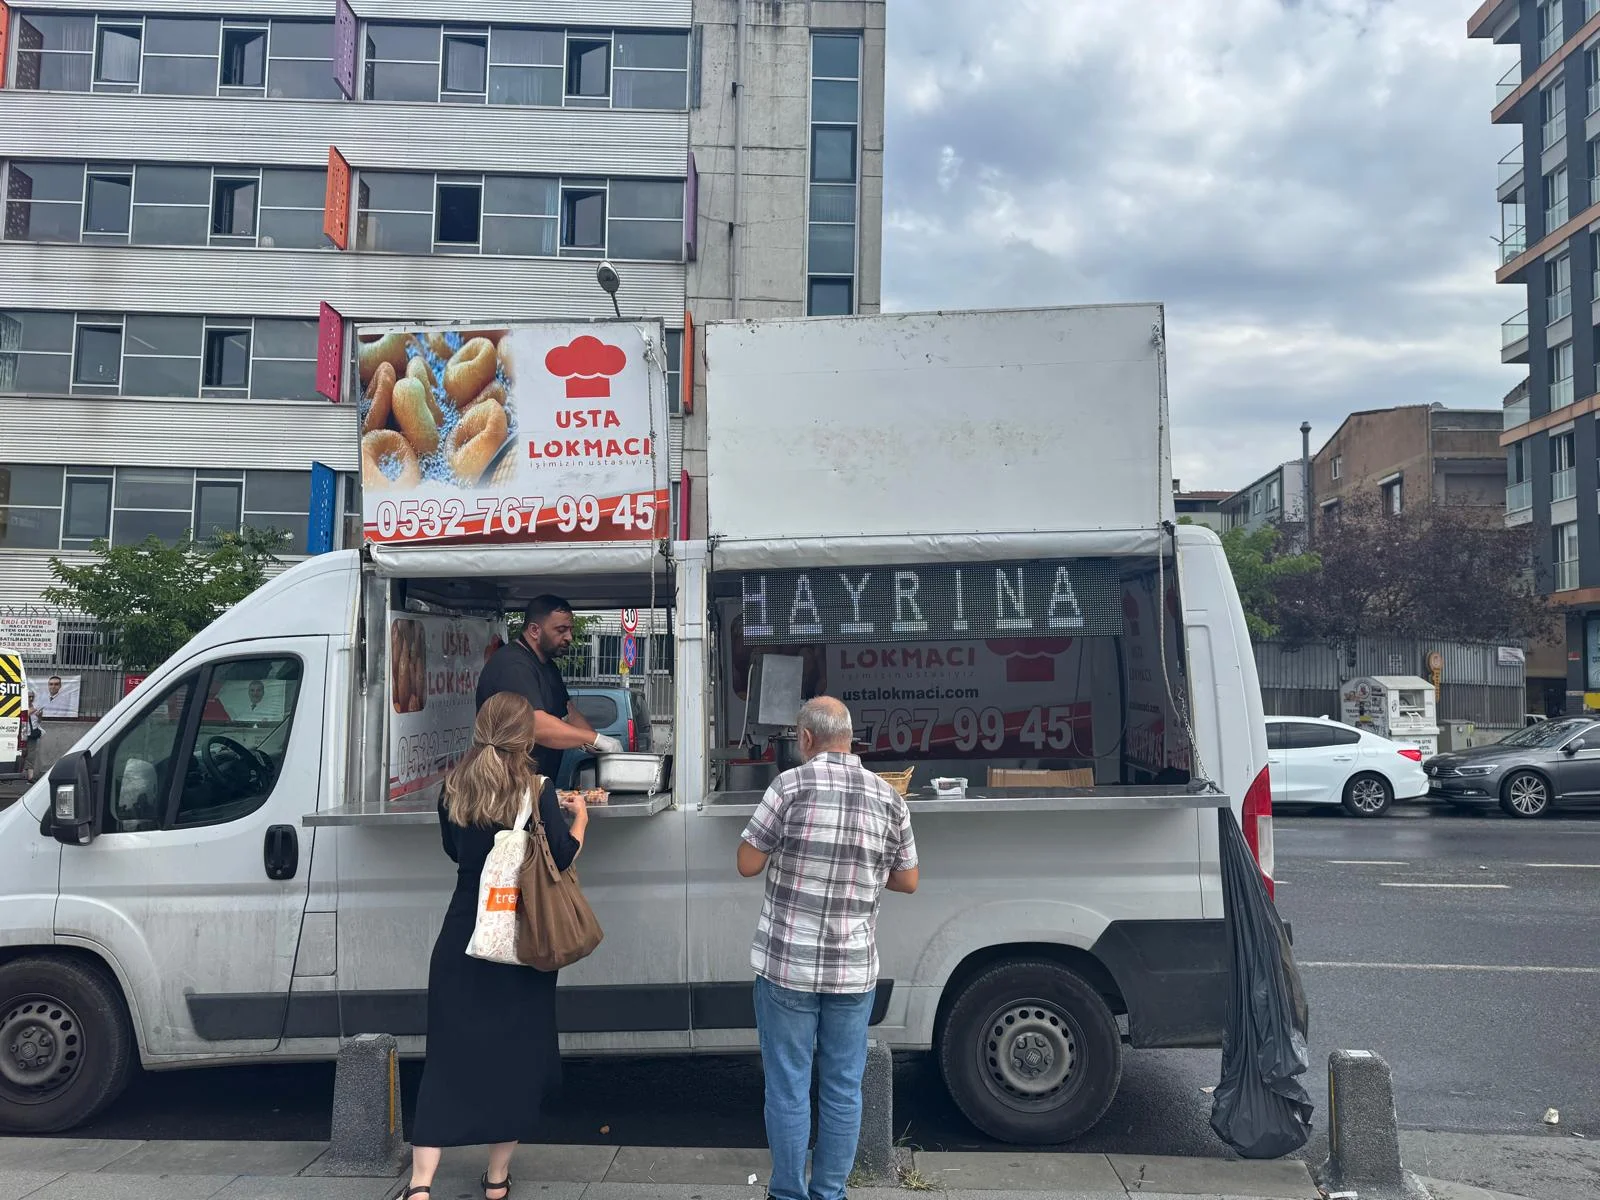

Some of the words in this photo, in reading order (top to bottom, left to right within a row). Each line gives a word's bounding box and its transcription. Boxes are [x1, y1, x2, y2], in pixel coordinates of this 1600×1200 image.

[556, 409, 621, 428] USTA
[528, 437, 651, 459] LOKMACI
[530, 459, 584, 470] işimizin
[377, 499, 466, 538] 0532
[477, 496, 544, 536] 767
[556, 494, 600, 533] 99
[612, 493, 656, 531] 45
[742, 566, 1085, 636] HAYRINA
[625, 608, 636, 623] 30
[442, 631, 472, 657] USTA
[840, 647, 976, 669] LOKMACI
[427, 669, 479, 696] LOKMAC
[842, 686, 979, 701] ustalokmaci.com
[861, 708, 939, 752] 767
[953, 706, 1005, 752] 99
[1019, 705, 1072, 751] 45
[495, 892, 519, 905] tre
